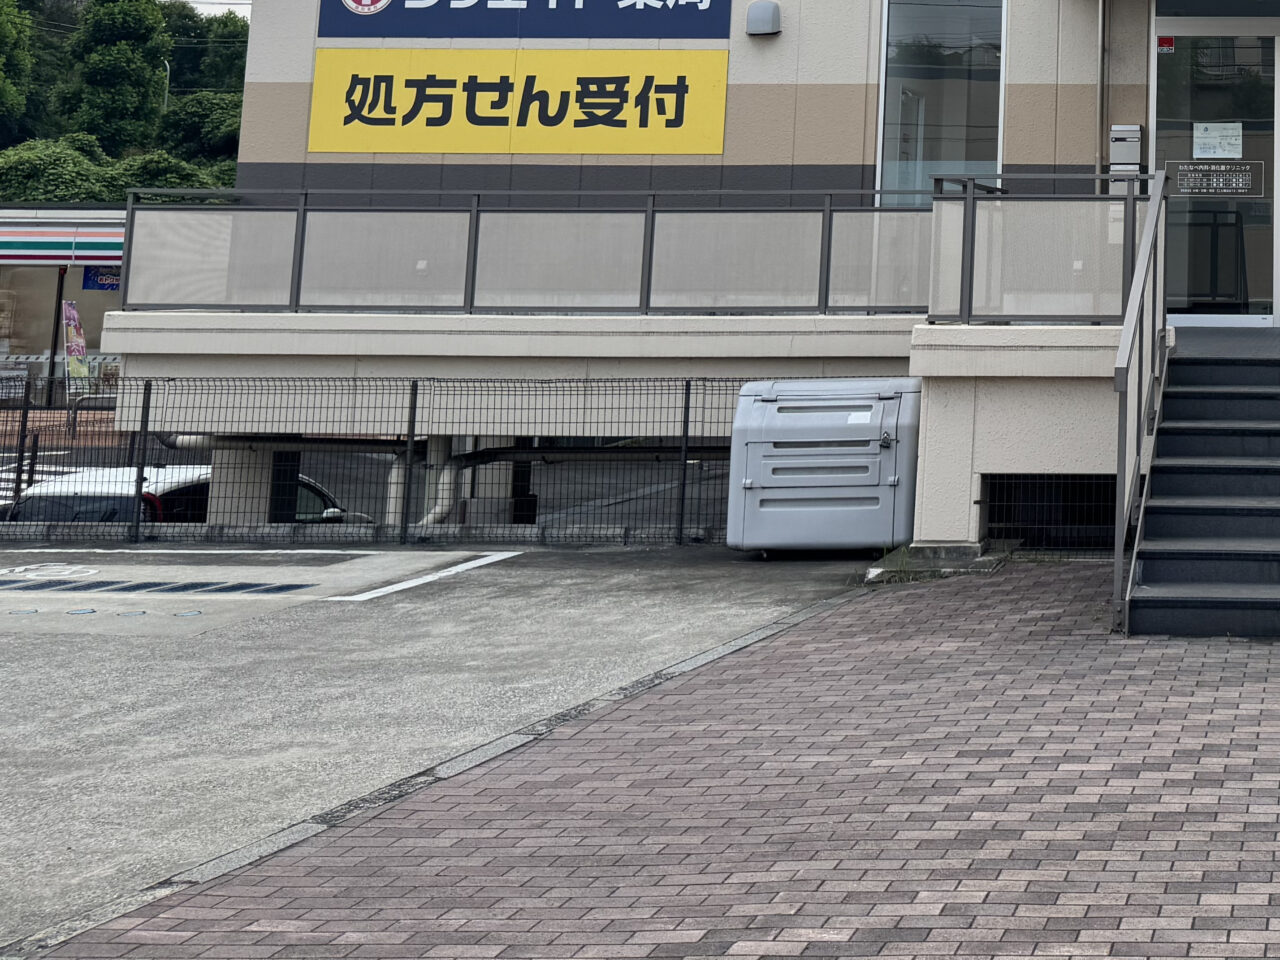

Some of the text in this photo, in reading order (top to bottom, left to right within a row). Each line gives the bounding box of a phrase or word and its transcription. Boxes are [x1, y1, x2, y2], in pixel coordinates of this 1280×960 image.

[343, 73, 689, 129] 処方せん受付
